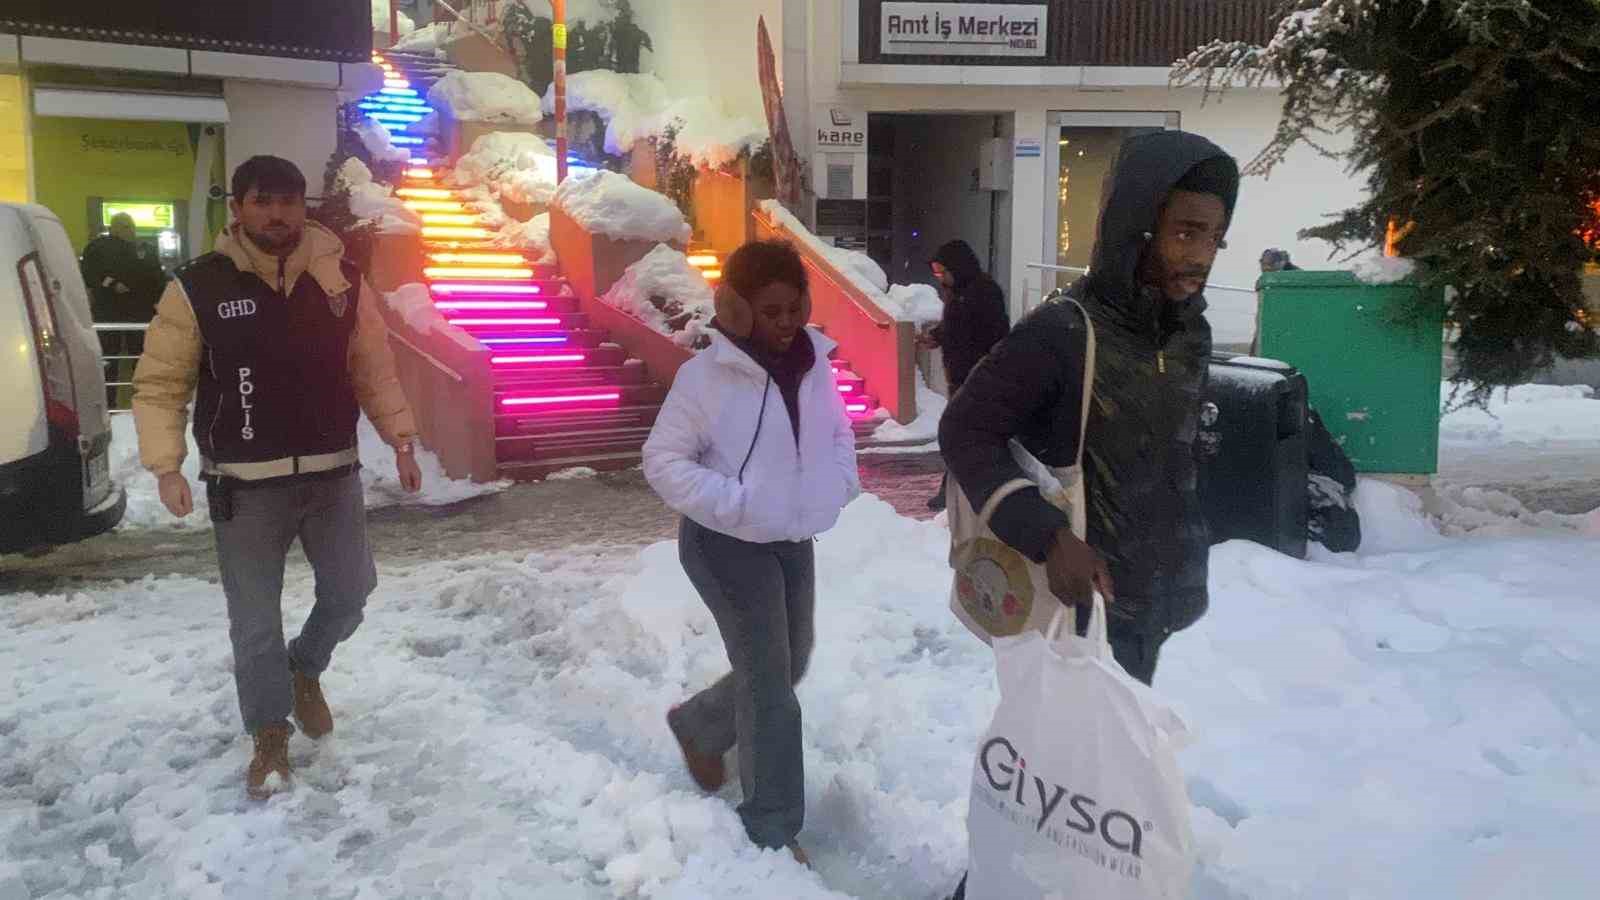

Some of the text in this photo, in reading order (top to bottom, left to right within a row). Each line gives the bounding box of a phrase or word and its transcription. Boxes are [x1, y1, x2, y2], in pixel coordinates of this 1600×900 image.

[958, 15, 1039, 37] Merkezi
[217, 299, 257, 319] GHD
[980, 736, 1144, 859] Giysa
